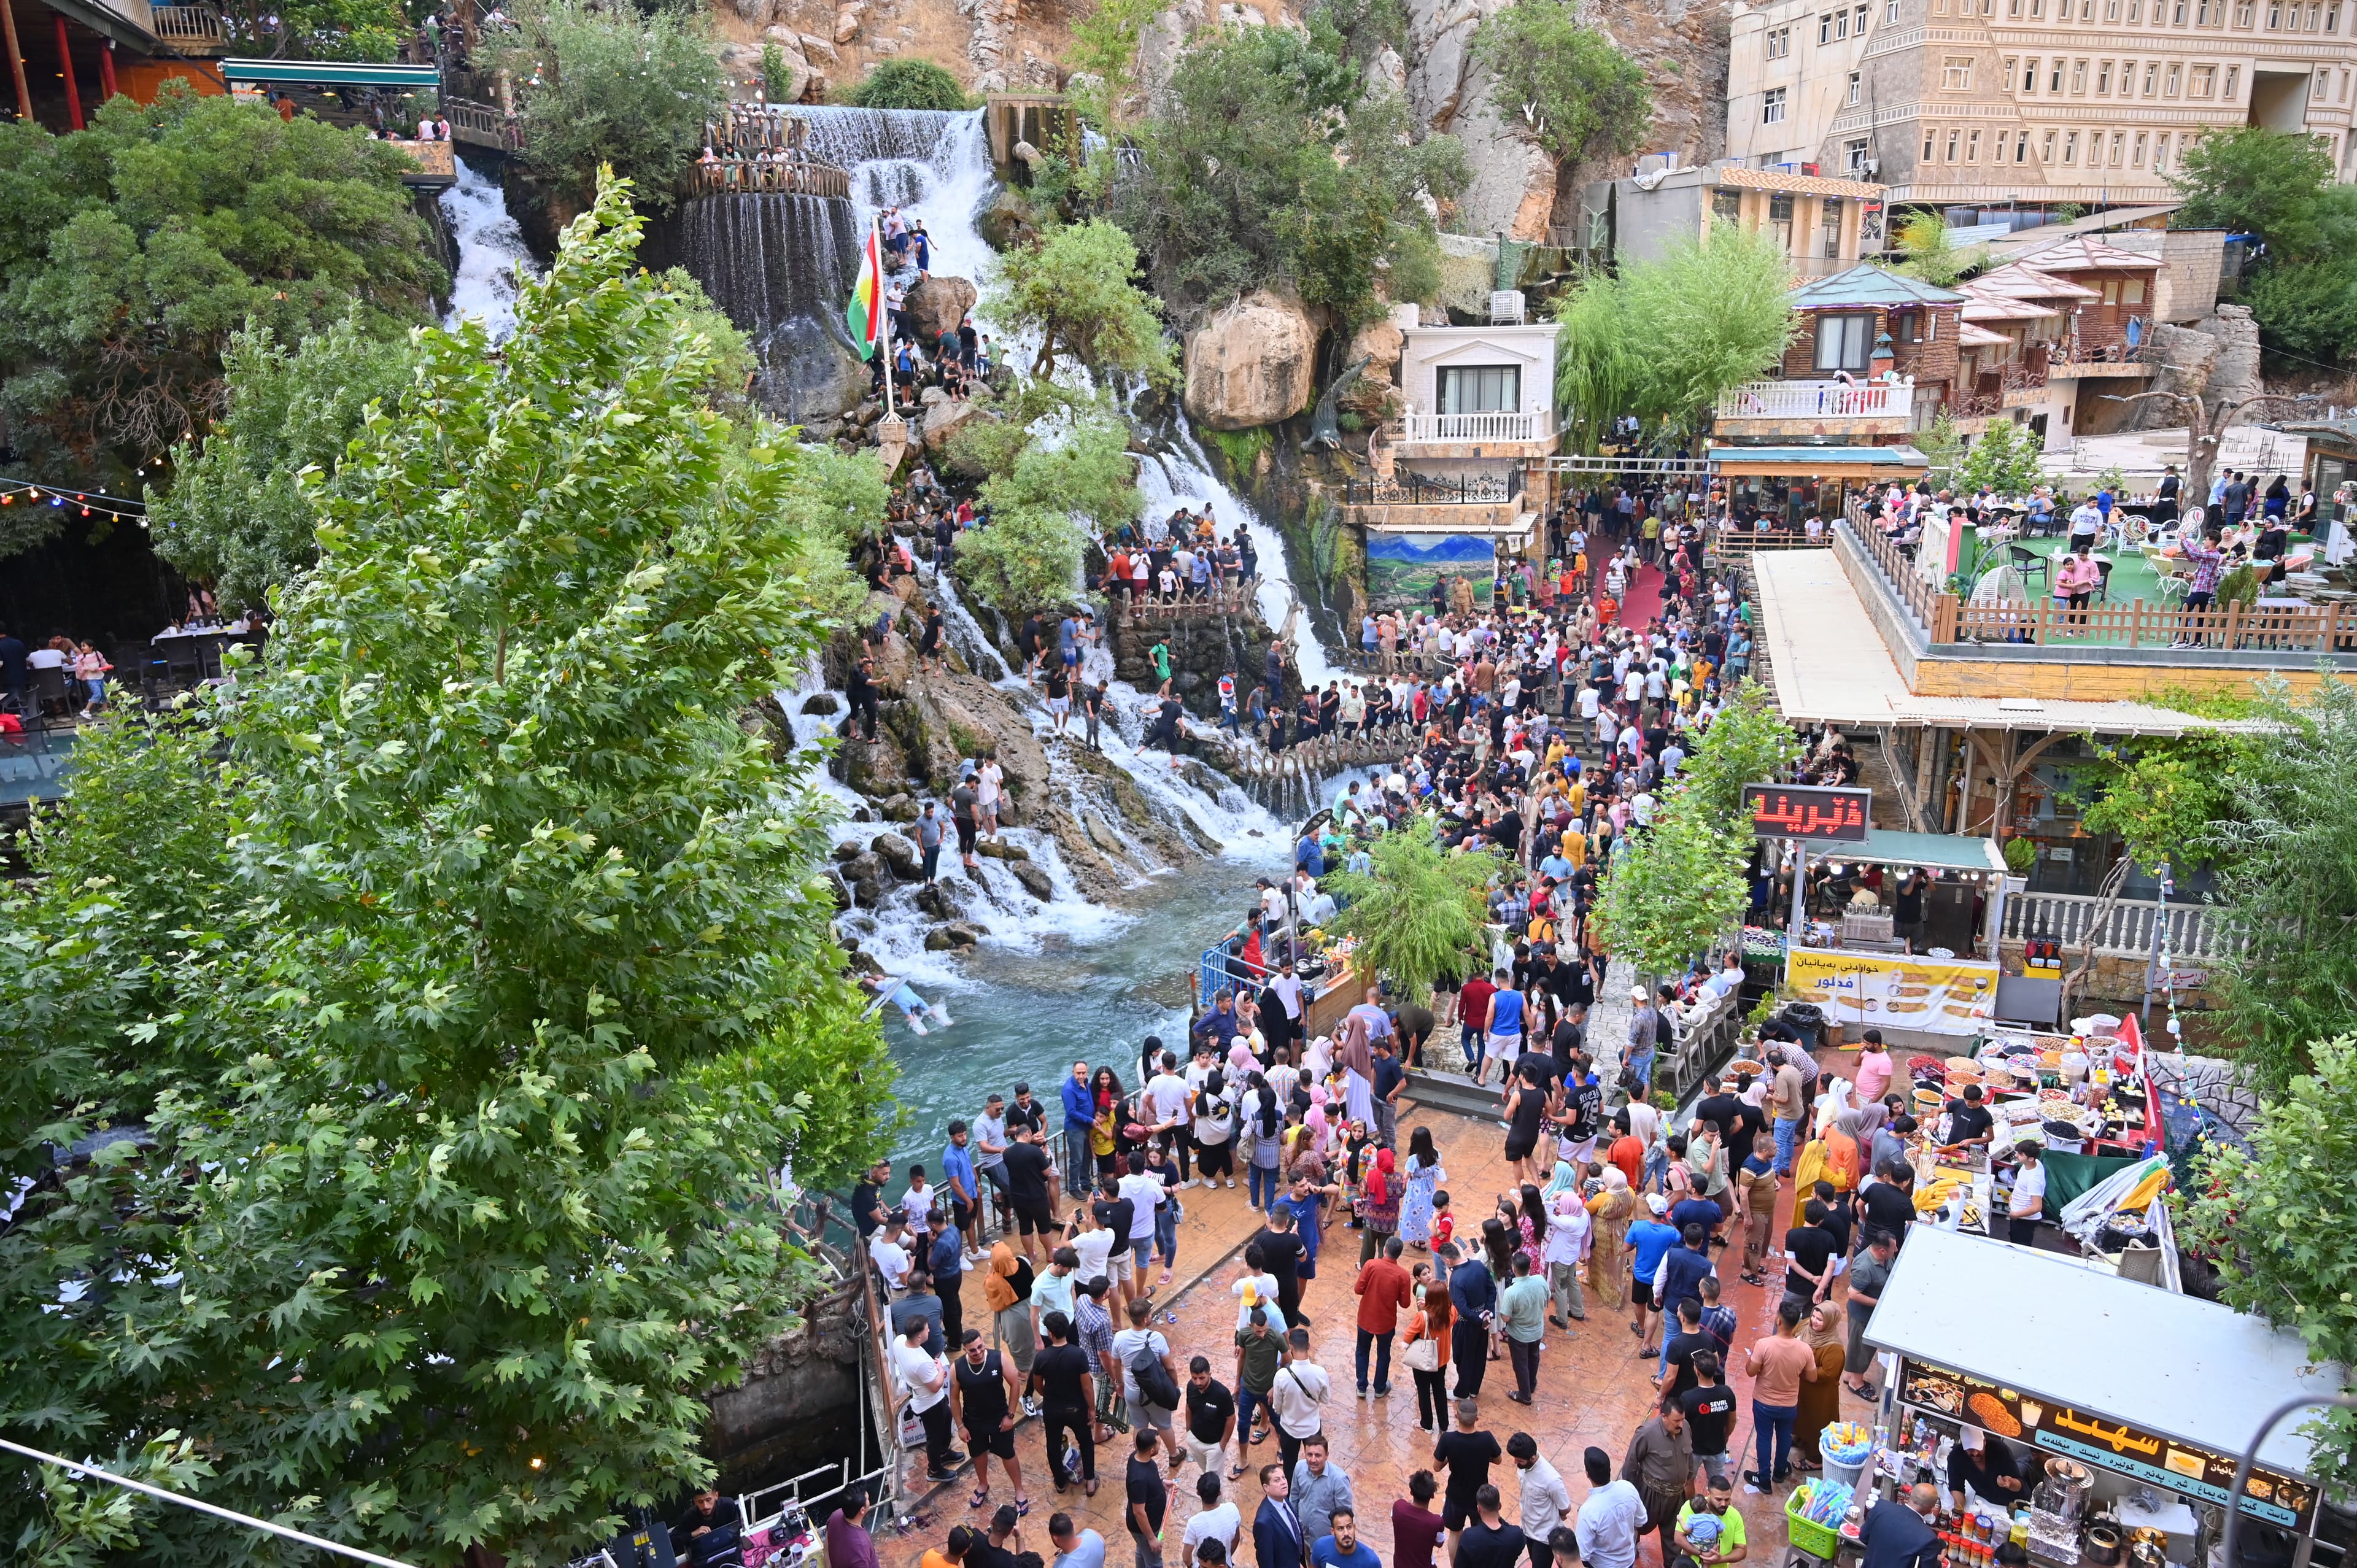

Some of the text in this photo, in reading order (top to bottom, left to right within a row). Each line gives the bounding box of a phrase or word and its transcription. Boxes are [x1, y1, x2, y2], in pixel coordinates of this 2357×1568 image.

[1710, 1399, 1727, 1408] SEVAL
[904, 1435, 914, 1444] Quick
[2267, 1508, 2289, 1521] ماست
